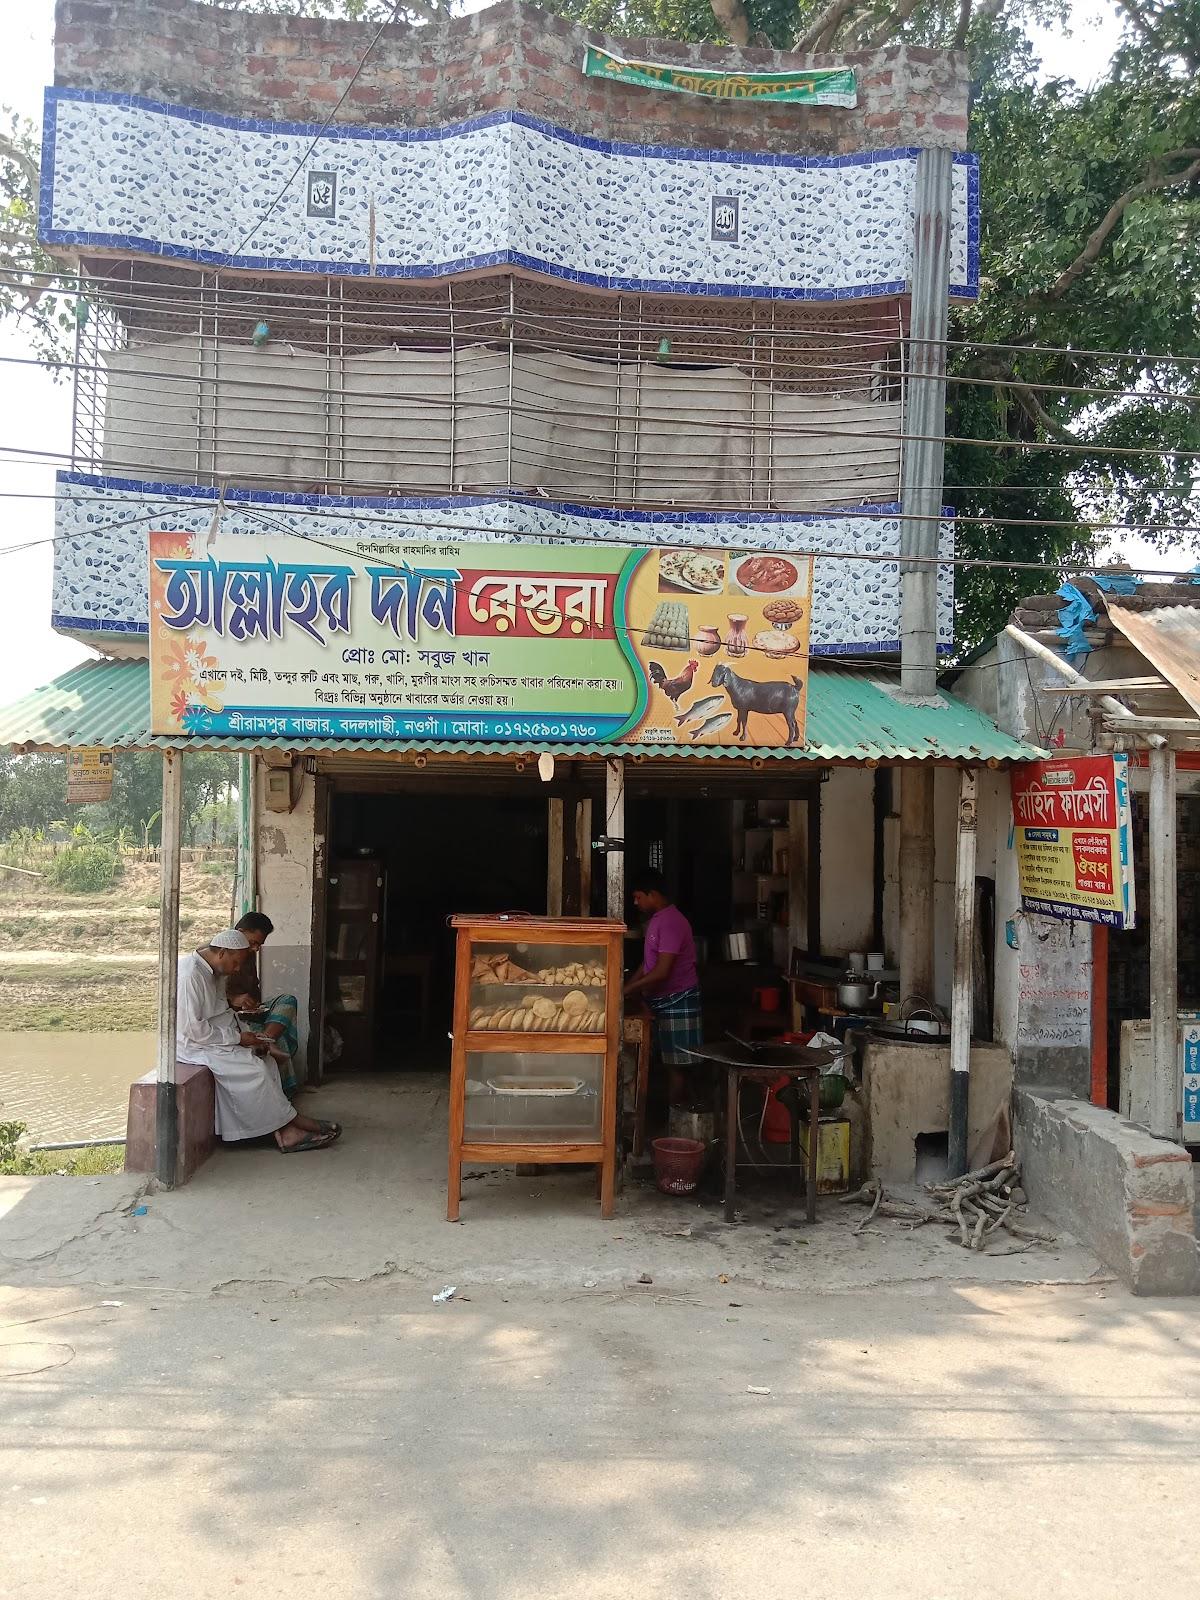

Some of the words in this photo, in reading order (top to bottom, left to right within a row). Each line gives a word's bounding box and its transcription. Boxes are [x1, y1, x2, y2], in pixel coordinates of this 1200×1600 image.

[356, 542, 400, 555] বিসমিল্লাহির
[402, 545, 436, 556] রাহমানির
[439, 545, 460, 556] রাহিম
[155, 552, 357, 647] আল্লাহর
[364, 558, 463, 643] দান
[417, 650, 457, 669] সবুজ
[462, 650, 490, 667] খান
[199, 669, 227, 681] এখানে
[230, 669, 247, 684] দই,
[249, 668, 272, 684] মিষ্টি,
[274, 671, 298, 685] তন্দুর
[300, 669, 319, 683] রুটি
[321, 672, 340, 684] এবং
[342, 672, 361, 686] মাছ,
[364, 673, 383, 687] গরু,
[385, 672, 408, 687] খাসি,
[411, 672, 438, 688] মুরগীর
[440, 674, 462, 687] মাংস
[463, 675, 478, 688] সহ
[479, 673, 518, 688] রুচিসম্মত
[520, 676, 544, 688] খাবার
[547, 675, 584, 689] পরিবেশন
[586, 679, 603, 690] করা
[340, 689, 366, 706] বিভিন্ন
[368, 690, 402, 706] অনুষ্ঠানে
[405, 692, 438, 704] খাবারের
[441, 690, 465, 705] অর্ডার
[467, 694, 494, 706] নেওয়া
[228, 711, 287, 735] শ্রীরামপুর
[291, 717, 335, 736] বাজার,
[339, 715, 400, 737] বদলগাছী,
[494, 722, 597, 738] ০১৭২৫৯০১৭৬০
[1015, 780, 1057, 825] রাহিদ
[1057, 775, 1110, 823] ফার্মেসী
[1076, 854, 1109, 880] ঔষধ
